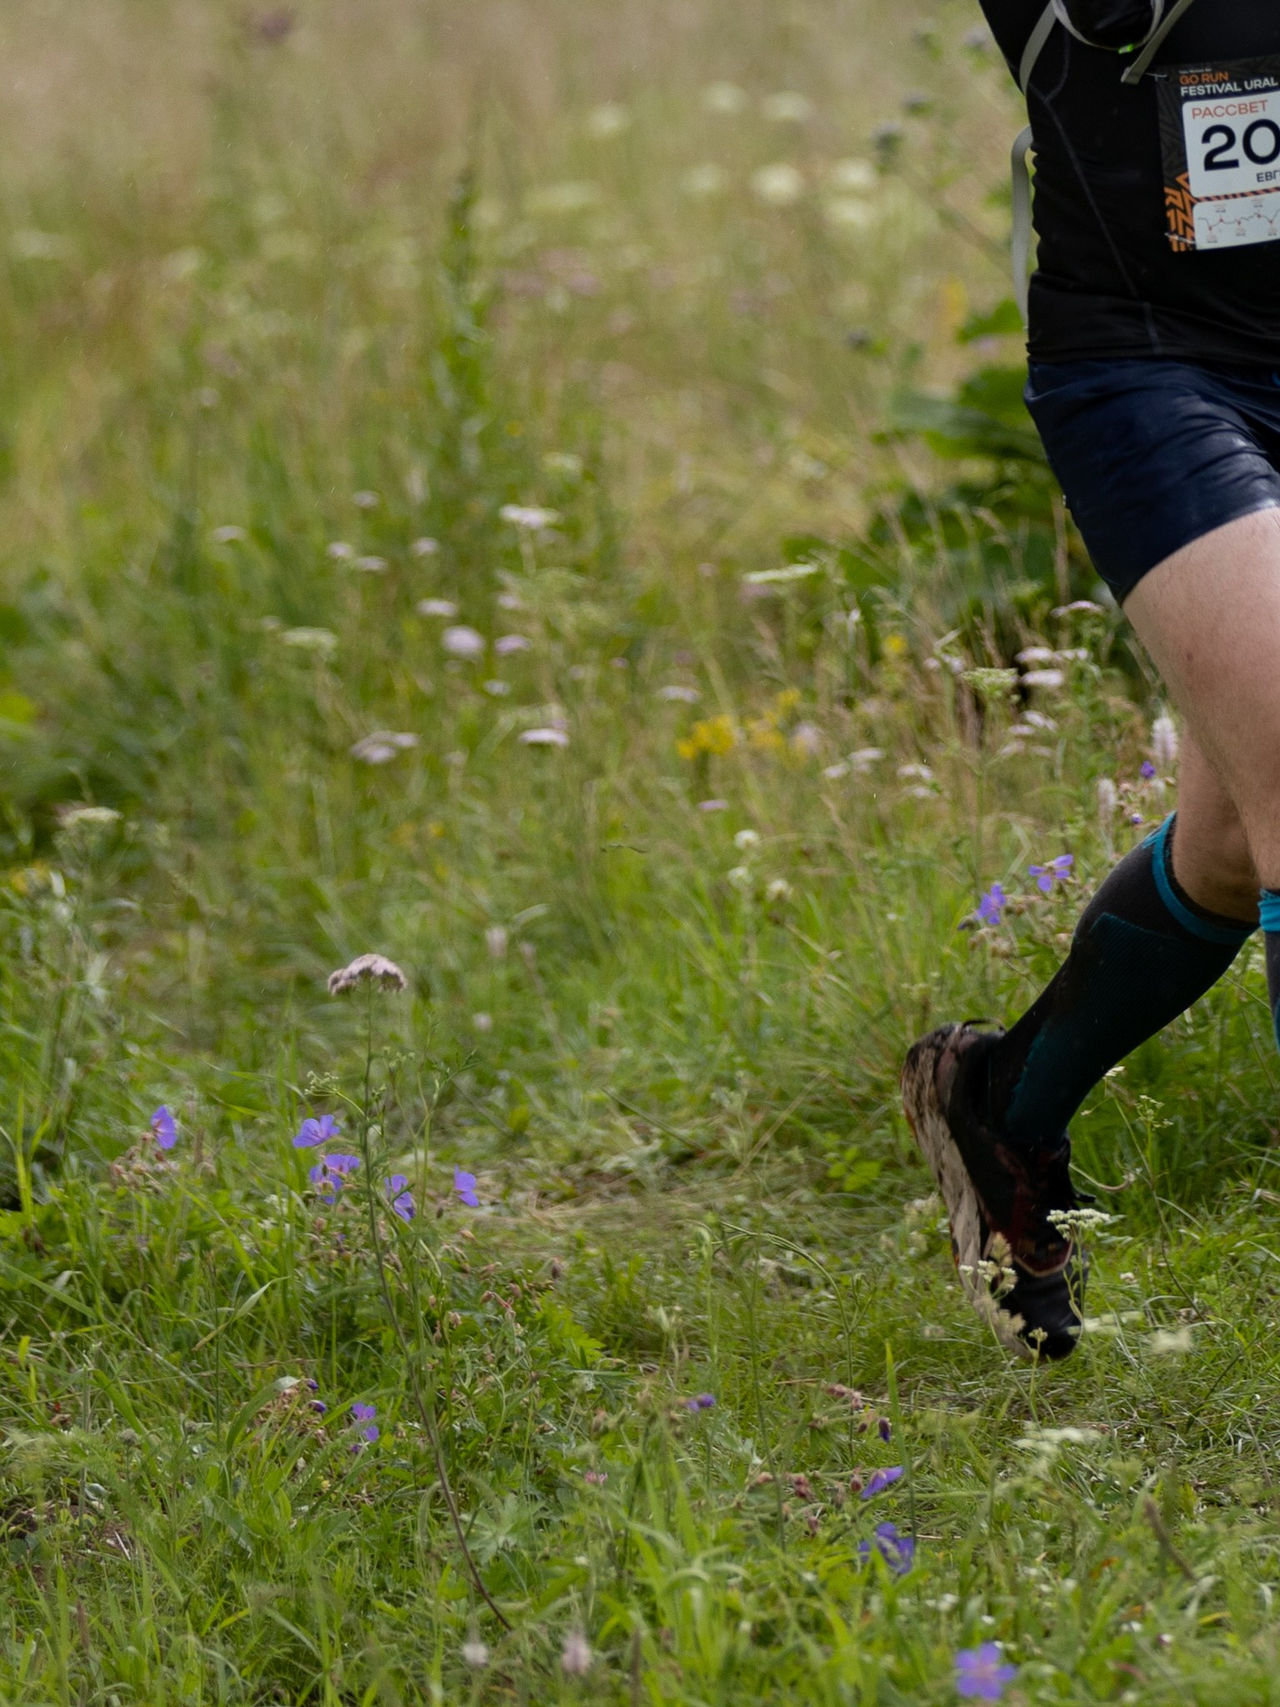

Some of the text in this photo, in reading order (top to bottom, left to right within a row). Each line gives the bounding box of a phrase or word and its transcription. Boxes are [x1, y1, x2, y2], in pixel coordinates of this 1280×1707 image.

[1179, 72, 1229, 85] GO RUN
[1180, 77, 1279, 97] FESTIVAL URAL
[1191, 100, 1268, 120] РАССВЕТ
